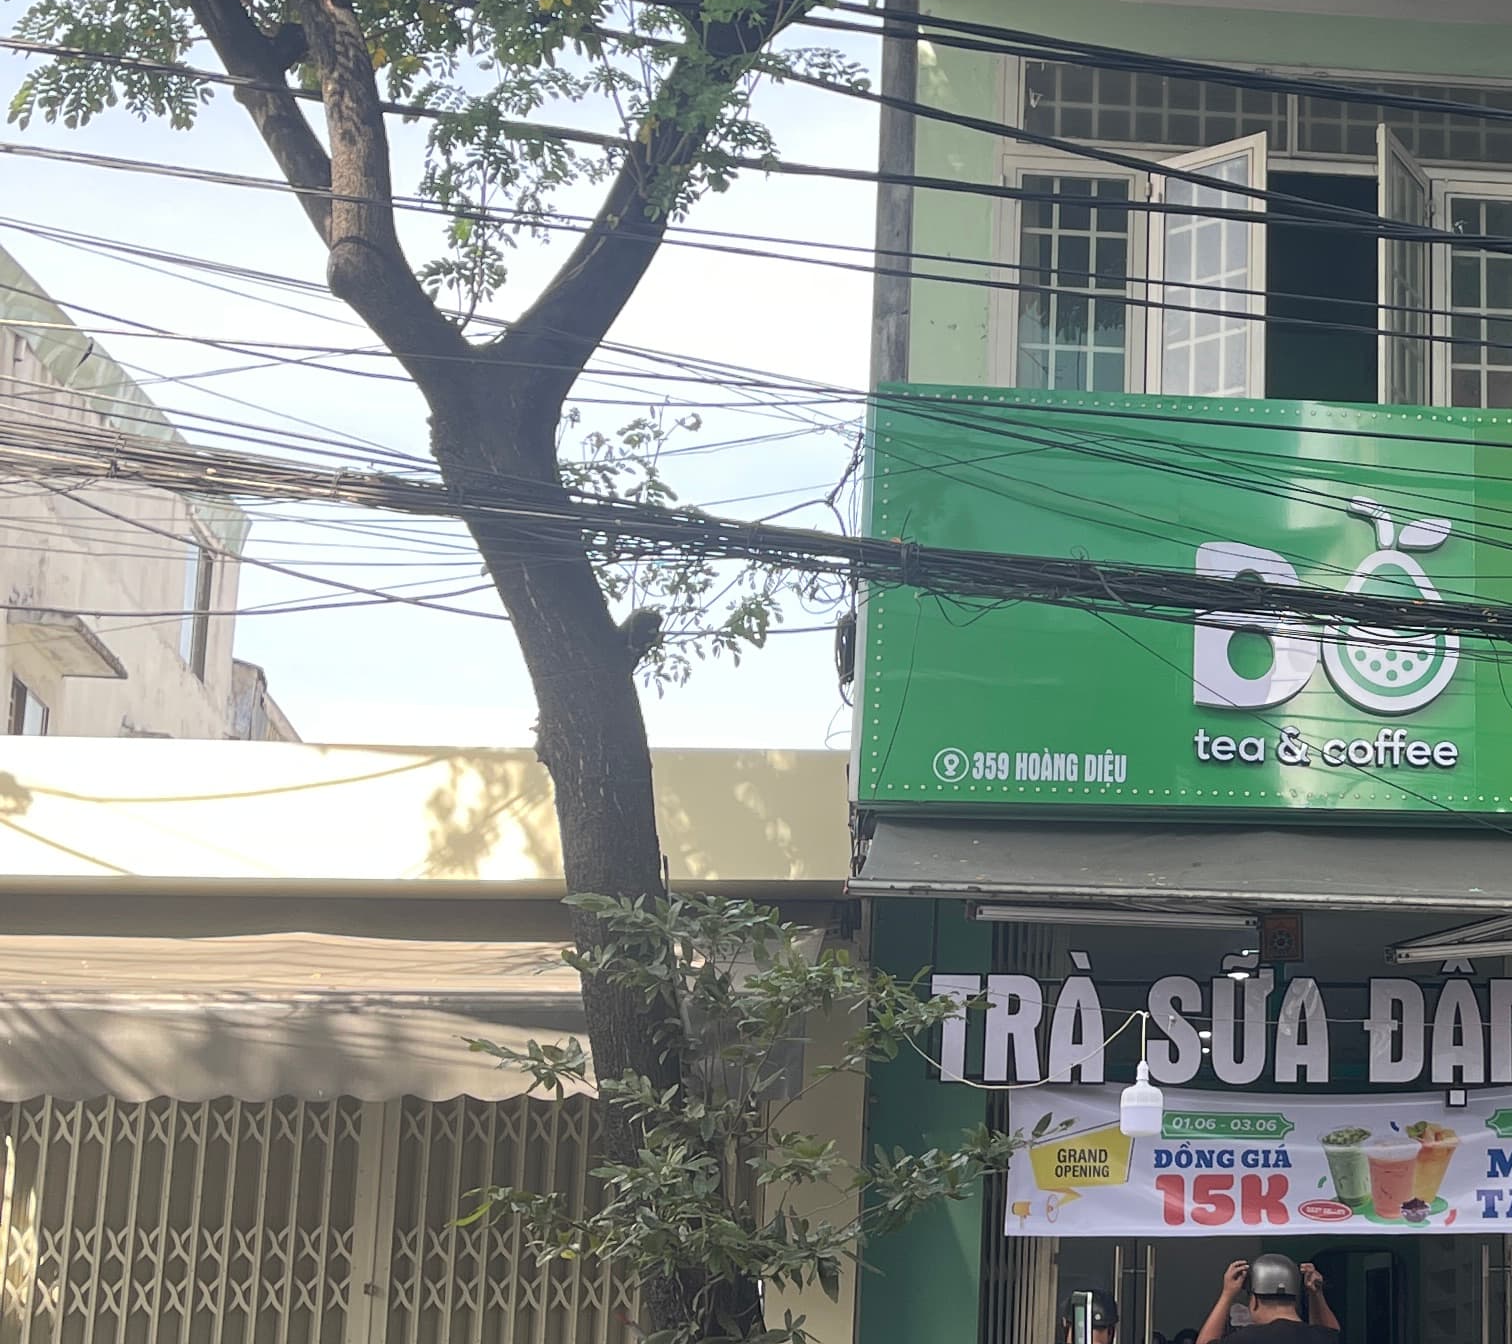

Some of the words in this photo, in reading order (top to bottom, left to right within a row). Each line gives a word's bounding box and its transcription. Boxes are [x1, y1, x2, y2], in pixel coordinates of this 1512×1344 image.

[1193, 727, 1266, 763] tea
[1276, 726, 1311, 766] &
[1323, 728, 1460, 767] coffee
[971, 751, 1010, 781] 359
[1015, 747, 1079, 782] HOÀNG
[1084, 749, 1128, 787] DIỆU
[930, 950, 1106, 1085] TRÀ
[1146, 953, 1331, 1086] SỮA
[1171, 1116, 1217, 1131] 01.06
[1230, 1118, 1278, 1133] 03.06
[1054, 1164, 1110, 1179] OPENING
[1057, 1148, 1109, 1165] GRAND
[1154, 1141, 1234, 1169] ĐỒNG
[1241, 1144, 1293, 1169] GIÁ
[1155, 1173, 1290, 1227] 15K
